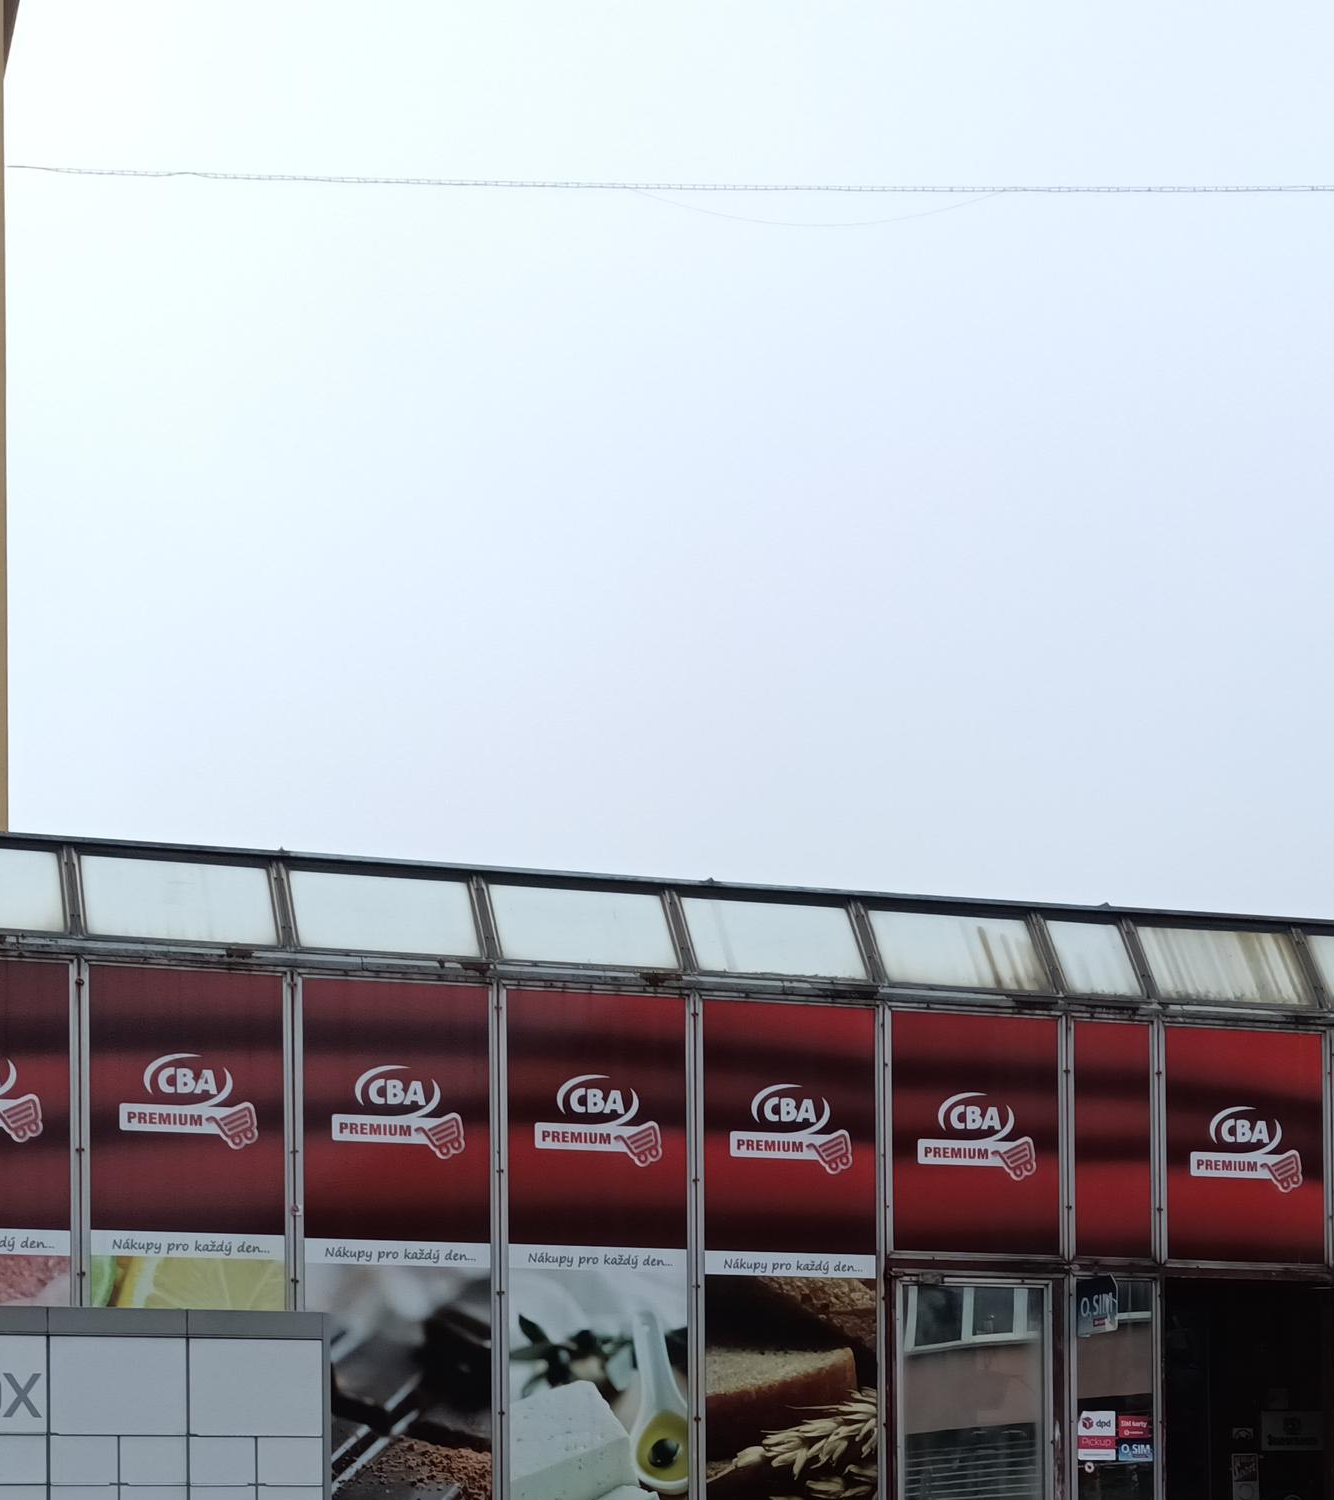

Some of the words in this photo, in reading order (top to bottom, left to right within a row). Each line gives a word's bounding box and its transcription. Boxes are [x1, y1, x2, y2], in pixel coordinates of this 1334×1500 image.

[158, 1067, 217, 1094] CBA
[369, 1079, 425, 1105] CBA
[570, 1088, 625, 1114] CBA
[764, 1097, 816, 1122] CBA
[127, 1112, 202, 1126] PREMIUM
[951, 1105, 1001, 1130] CBA
[339, 1122, 411, 1136] PREMIUM
[1221, 1119, 1269, 1143] CBA
[542, 1130, 611, 1144] PREMIUM
[737, 1139, 803, 1152] PREMIUM
[925, 1147, 988, 1159] PREMIUM
[1197, 1159, 1257, 1172] PREMIUM
[20, 1236, 55, 1250] den...
[112, 1238, 162, 1255] Nákupy
[166, 1241, 189, 1256] pro
[195, 1240, 231, 1257] každý
[236, 1242, 270, 1254] den...
[325, 1247, 373, 1263] Nákupy
[378, 1249, 400, 1264] pro
[405, 1247, 441, 1264] každý
[445, 1249, 476, 1263] den...
[528, 1253, 574, 1268] Nákupy
[579, 1254, 600, 1269] pro
[605, 1253, 639, 1270] každý
[643, 1255, 673, 1268] den...
[724, 1259, 767, 1274] Nákupy
[771, 1261, 792, 1275] pro
[796, 1259, 830, 1275] každý
[834, 1261, 863, 1273] den...
[1096, 1419, 1111, 1429] dpd
[1082, 1437, 1111, 1447] Pickup
[1132, 1444, 1150, 1455] SIM
